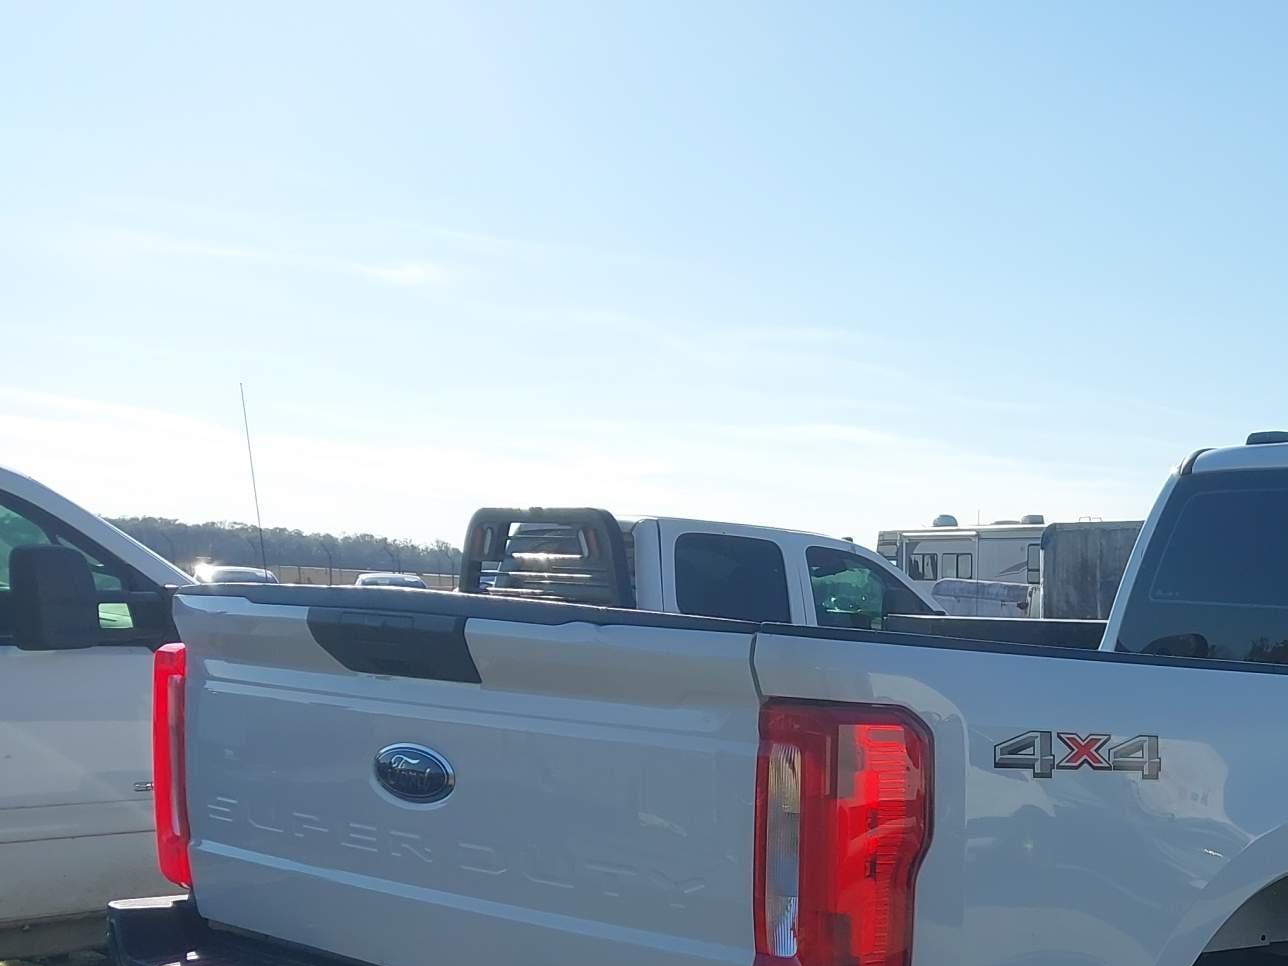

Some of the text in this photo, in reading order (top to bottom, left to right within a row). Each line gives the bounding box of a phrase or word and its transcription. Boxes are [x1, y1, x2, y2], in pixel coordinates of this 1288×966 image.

[387, 753, 432, 791] Ford
[207, 796, 706, 910] SUPER DUTY
